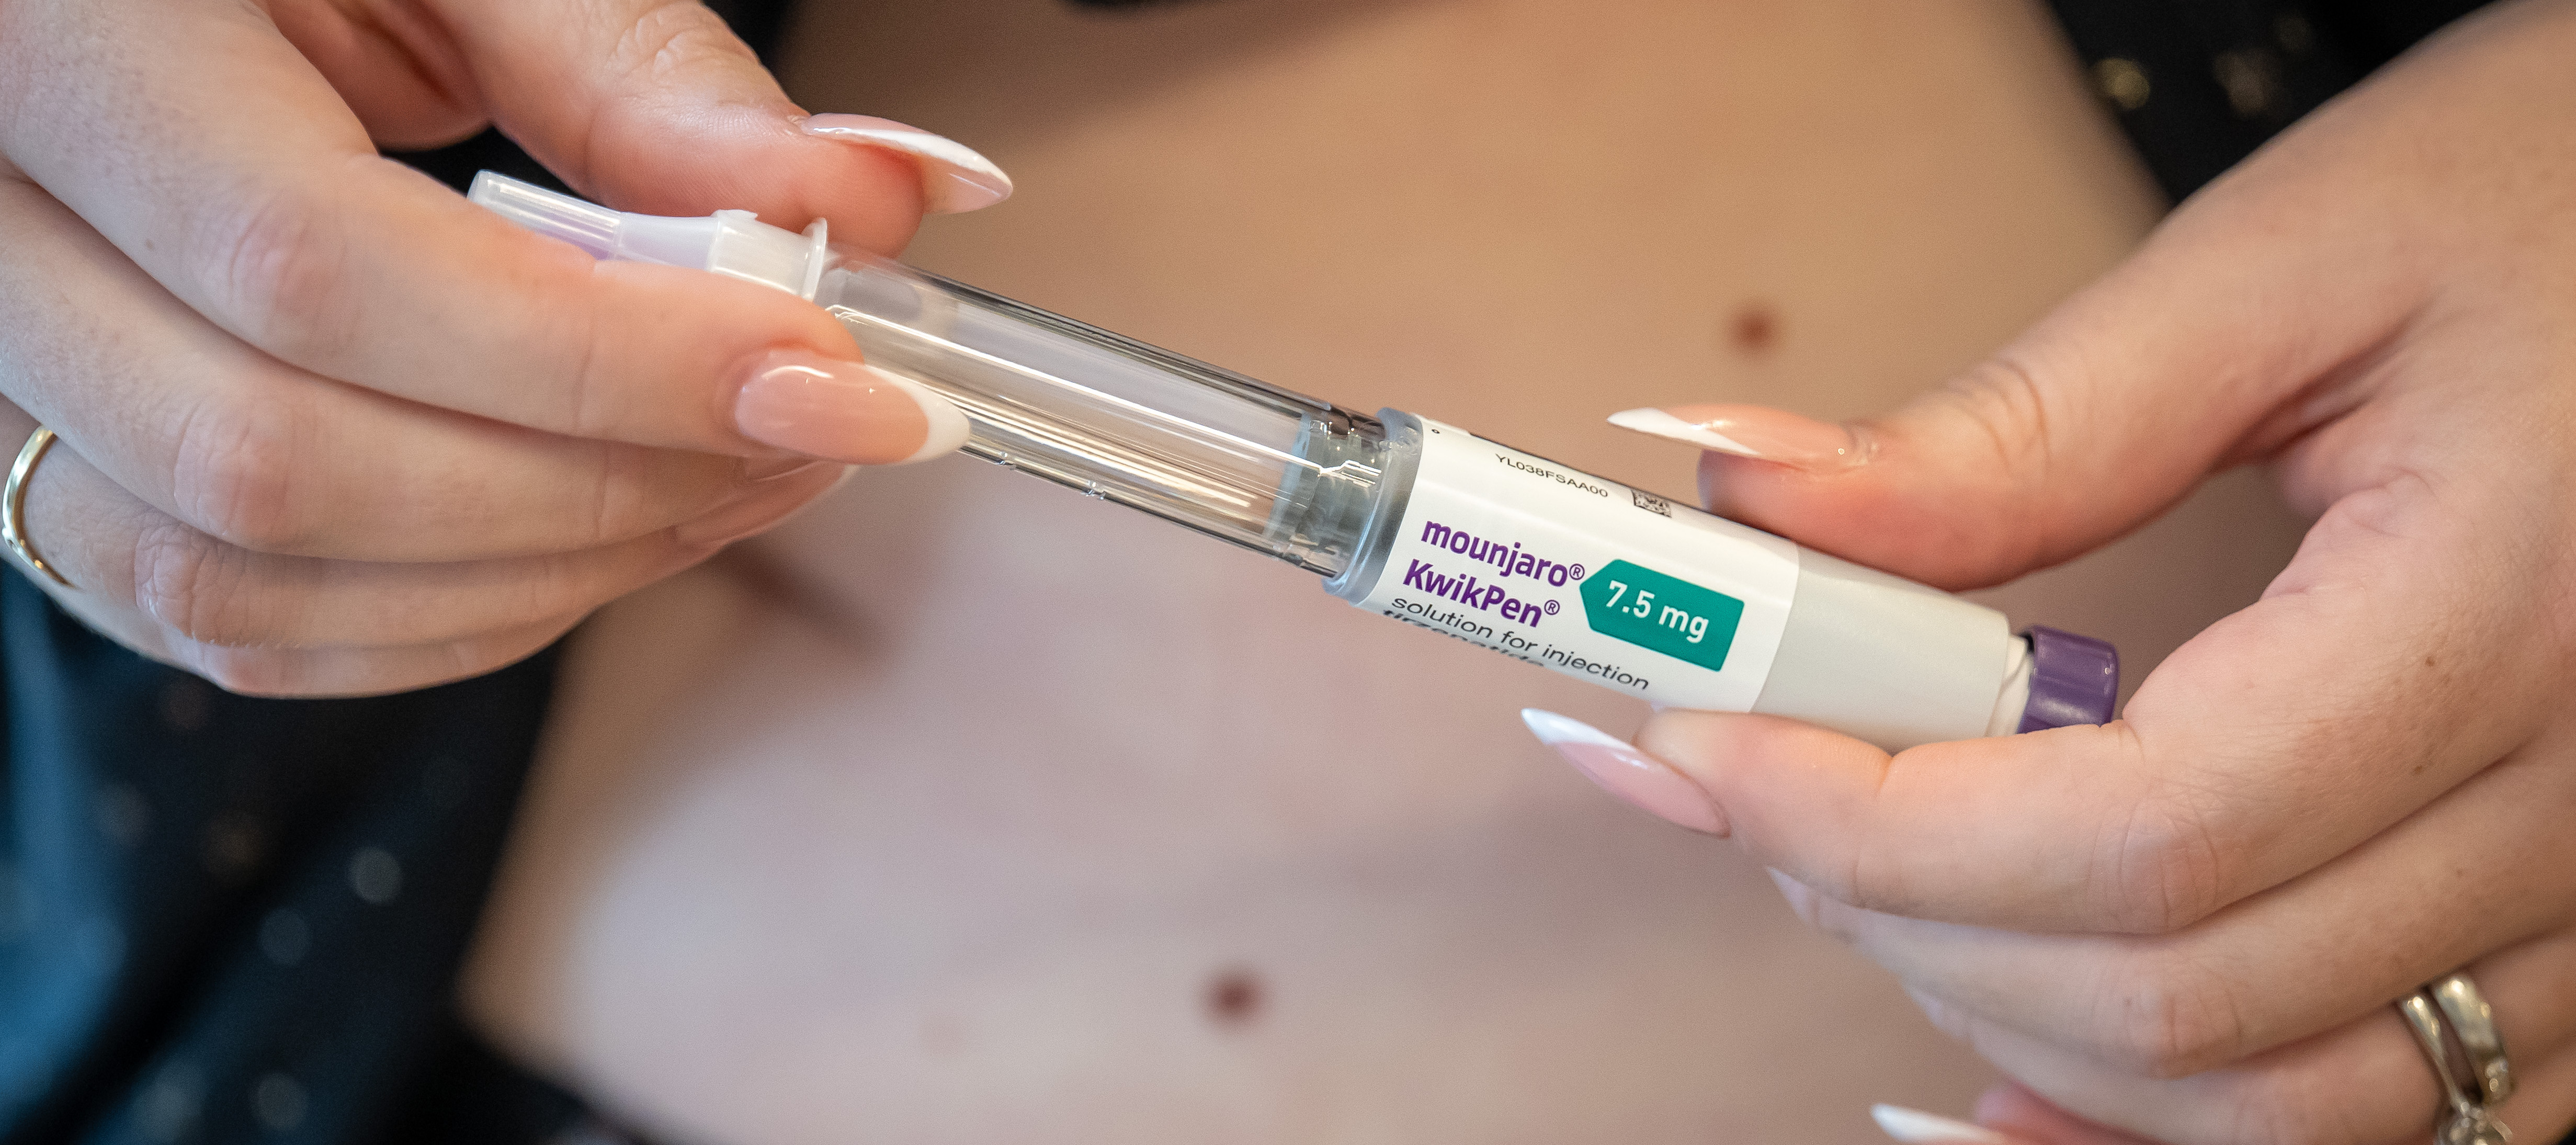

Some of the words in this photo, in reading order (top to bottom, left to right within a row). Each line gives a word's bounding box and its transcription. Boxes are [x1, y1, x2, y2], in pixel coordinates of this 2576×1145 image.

[1392, 598, 1493, 638] solution
[1501, 631, 1538, 652] for
[1542, 644, 1649, 690] injection
[1606, 580, 1655, 618] 7.5
[1659, 605, 1709, 643] mg
